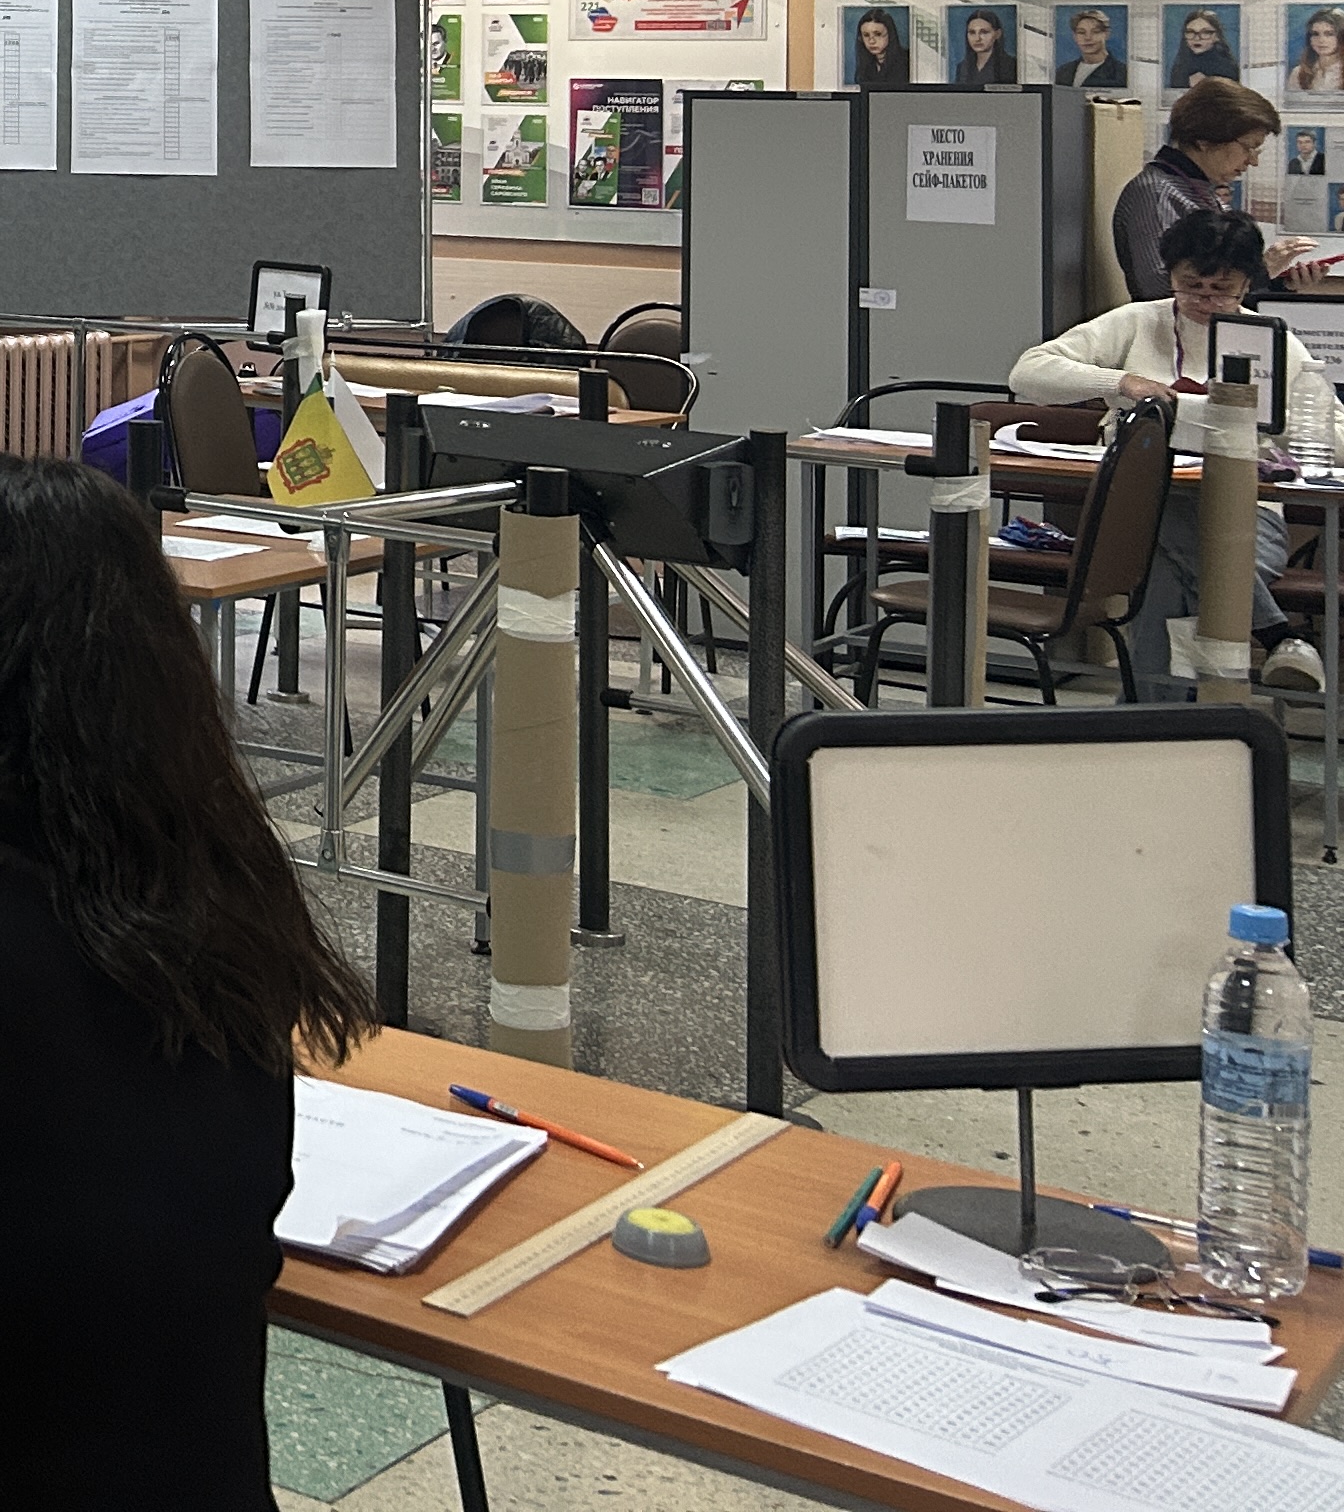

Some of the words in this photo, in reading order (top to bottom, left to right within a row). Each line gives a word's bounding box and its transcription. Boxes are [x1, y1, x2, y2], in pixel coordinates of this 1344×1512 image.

[607, 96, 660, 105] НАВИГАТОР
[592, 104, 659, 114] ПОСТУПЛЕНИЯ
[931, 128, 965, 144] МЕСТО
[922, 150, 974, 166] ХРАНЕНИЯ
[912, 169, 987, 189] СЕЙФ-ПАКЕТОВ
